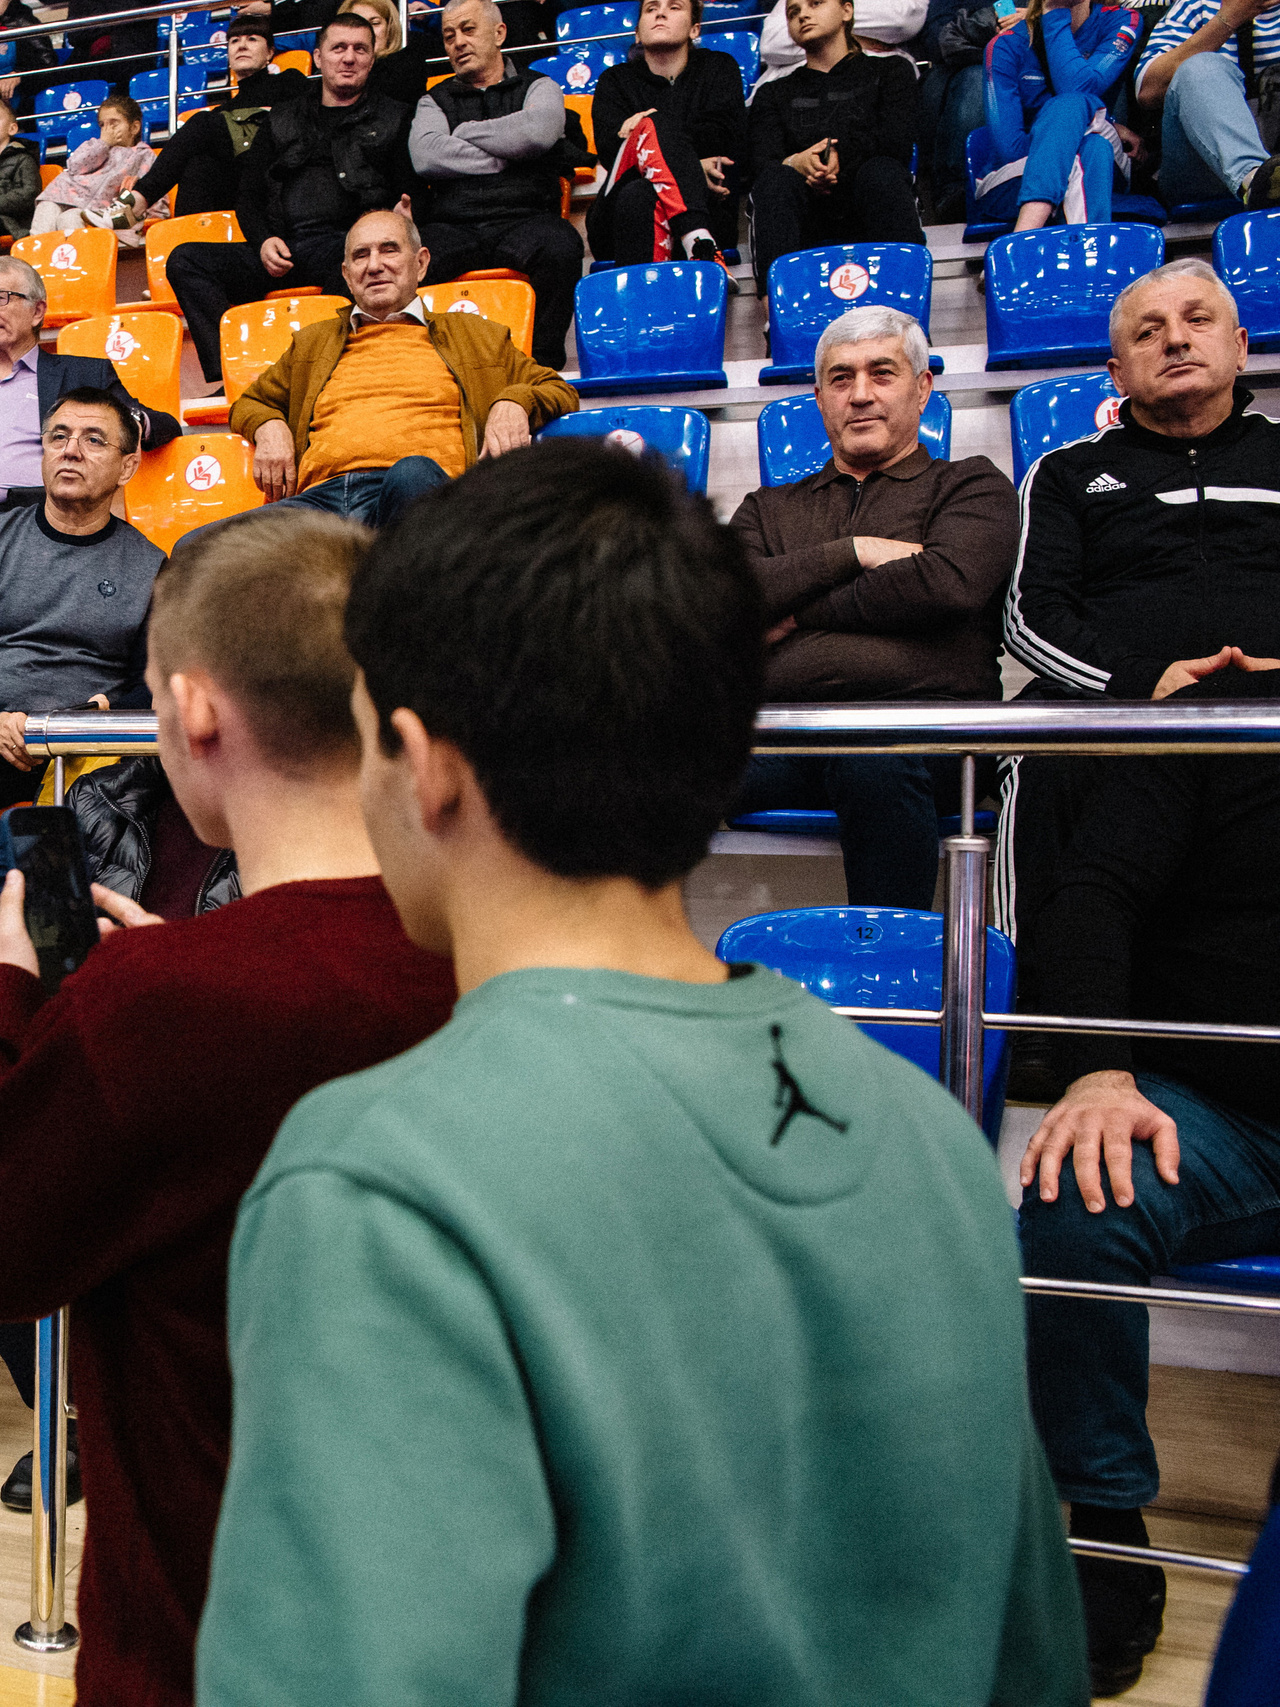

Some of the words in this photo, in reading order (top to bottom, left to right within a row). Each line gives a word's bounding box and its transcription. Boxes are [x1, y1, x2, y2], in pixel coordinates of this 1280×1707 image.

[460, 289, 470, 297] 10
[200, 444, 206, 452] 9
[1085, 482, 1128, 494] adidas
[856, 926, 874, 940] 12
